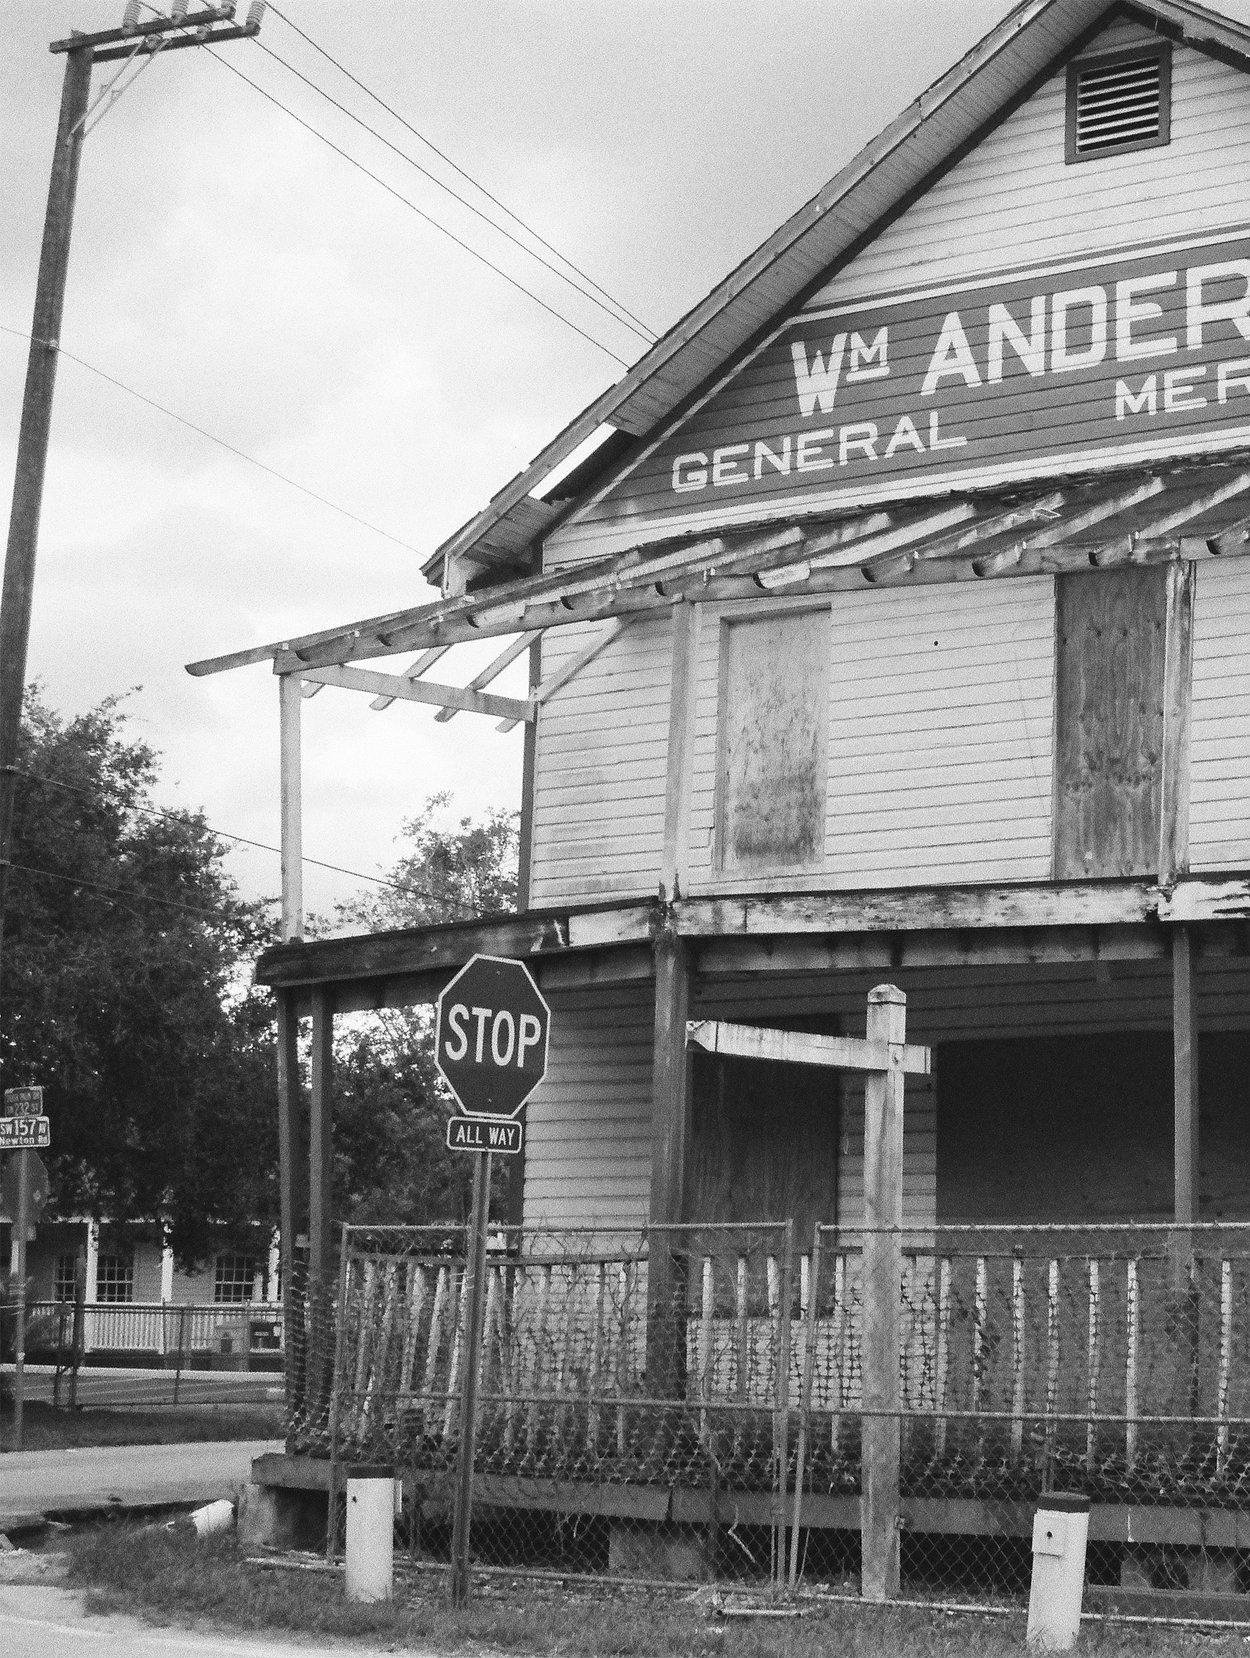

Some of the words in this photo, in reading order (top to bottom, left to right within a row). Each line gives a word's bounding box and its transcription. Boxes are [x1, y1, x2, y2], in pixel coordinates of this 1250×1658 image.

[672, 411, 967, 494] GENERAL
[445, 1004, 541, 1068] STOP
[0, 1123, 13, 1135] SW
[14, 1119, 36, 1136] 157
[456, 1125, 483, 1144] ALL
[489, 1127, 515, 1146] WAY
